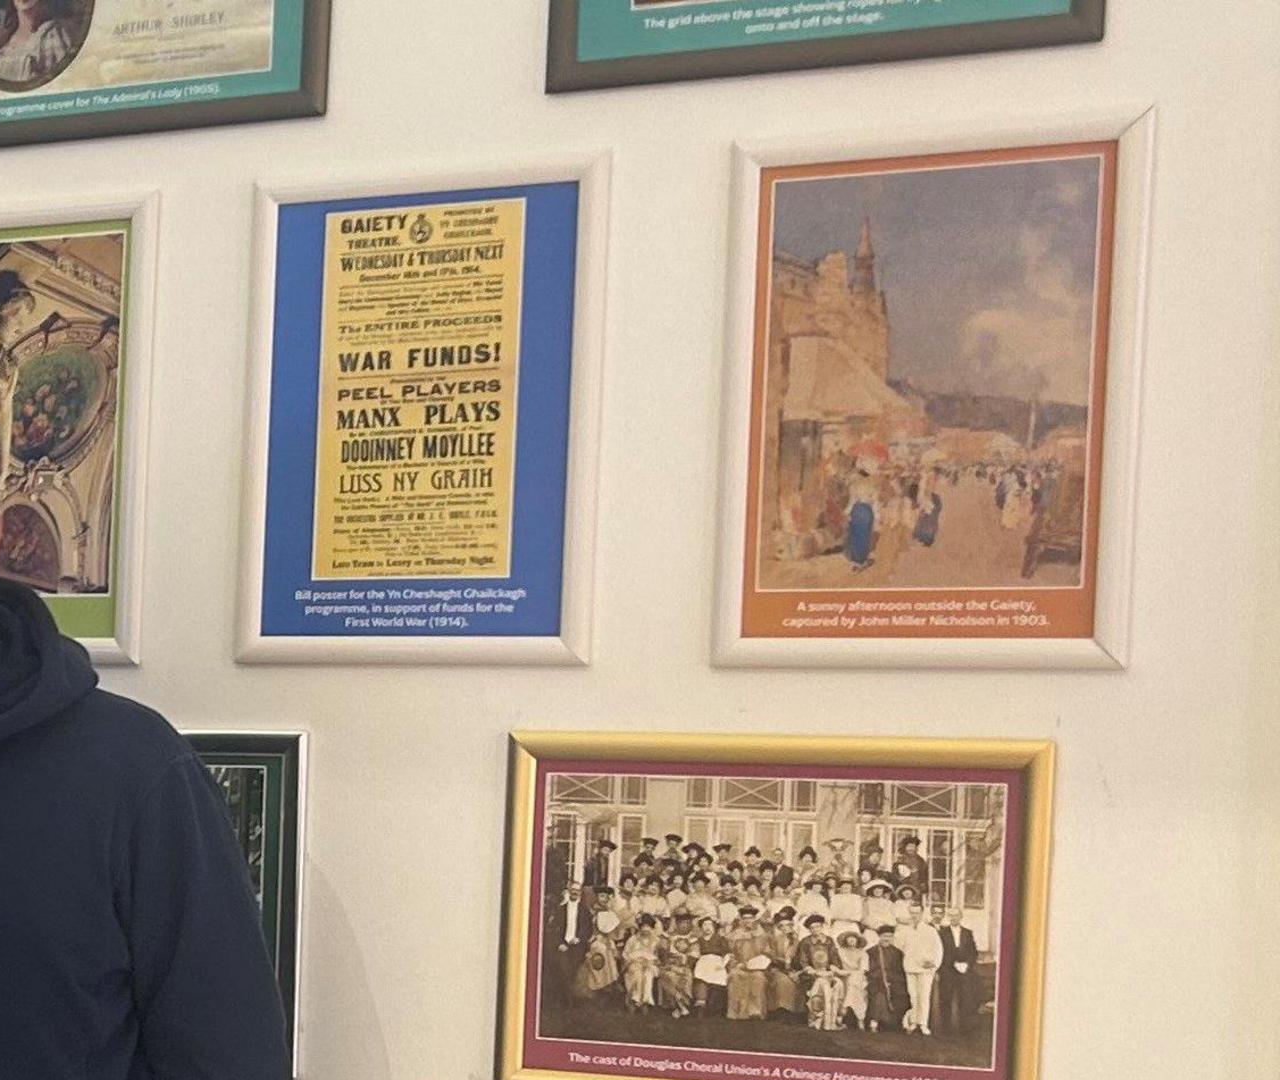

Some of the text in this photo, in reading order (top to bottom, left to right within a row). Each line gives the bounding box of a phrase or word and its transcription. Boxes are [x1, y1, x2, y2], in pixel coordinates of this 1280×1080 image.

[644, 6, 789, 29] The grid above the stage
[776, 15, 841, 30] and off the
[47, 100, 74, 111] cover
[92, 95, 109, 106] The
[340, 213, 409, 235] GAIETY
[340, 244, 504, 272] WEDNESDAY THURSDAY NEXT
[364, 314, 502, 333] ENTIRE PROCEEDS
[338, 341, 501, 373] WAR FUNDS!
[337, 387, 393, 401] PEEL
[401, 379, 501, 397] PLAYERS
[336, 400, 501, 430] MANX PLAYS
[341, 432, 496, 463] DOOINNEY MOYLLEE
[340, 467, 493, 494] LUSS NY GRAIH
[313, 589, 402, 603] poster for the Yn
[796, 600, 988, 614] A sunny afternoon outside the
[304, 602, 514, 617] programme, in support of funds for the
[345, 617, 469, 629] First World War (1914).
[781, 614, 1010, 629] captured by John Miller Nicholson in
[568, 1052, 590, 1065] The
[591, 1054, 616, 1067] cast
[618, 1055, 631, 1067] of
[633, 1056, 682, 1073] Douglas
[683, 1059, 723, 1074] Choral
[724, 1062, 770, 1077] Union's
[771, 1067, 781, 1078] A
[783, 1067, 832, 1080] Chinese
